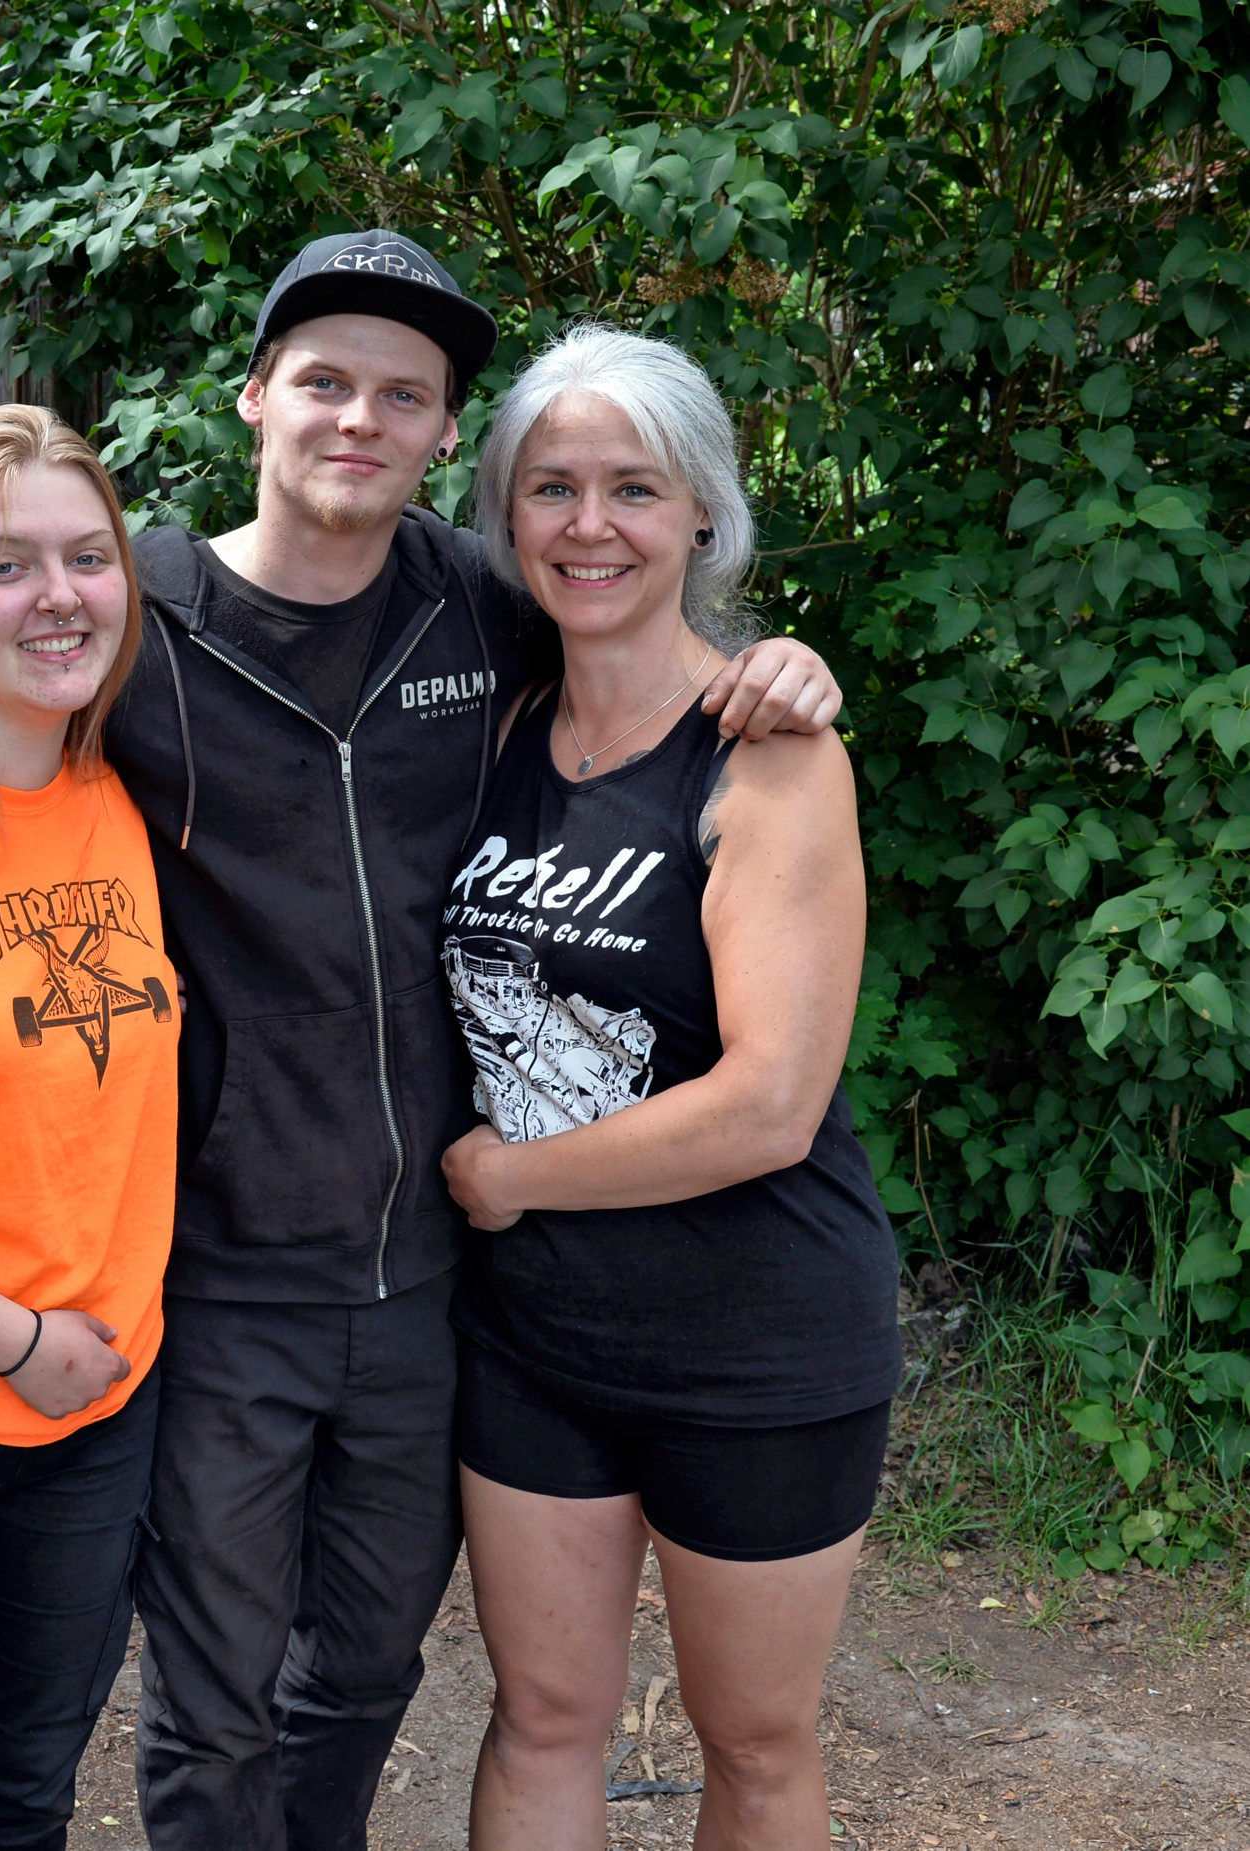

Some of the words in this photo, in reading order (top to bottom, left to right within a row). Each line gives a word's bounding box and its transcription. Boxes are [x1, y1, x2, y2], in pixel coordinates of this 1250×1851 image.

[419, 701, 480, 720] WORKWEAR
[450, 836, 665, 919] Rebell
[458, 905, 534, 933] Throttle
[553, 923, 581, 943] Go
[583, 927, 647, 952] Home
